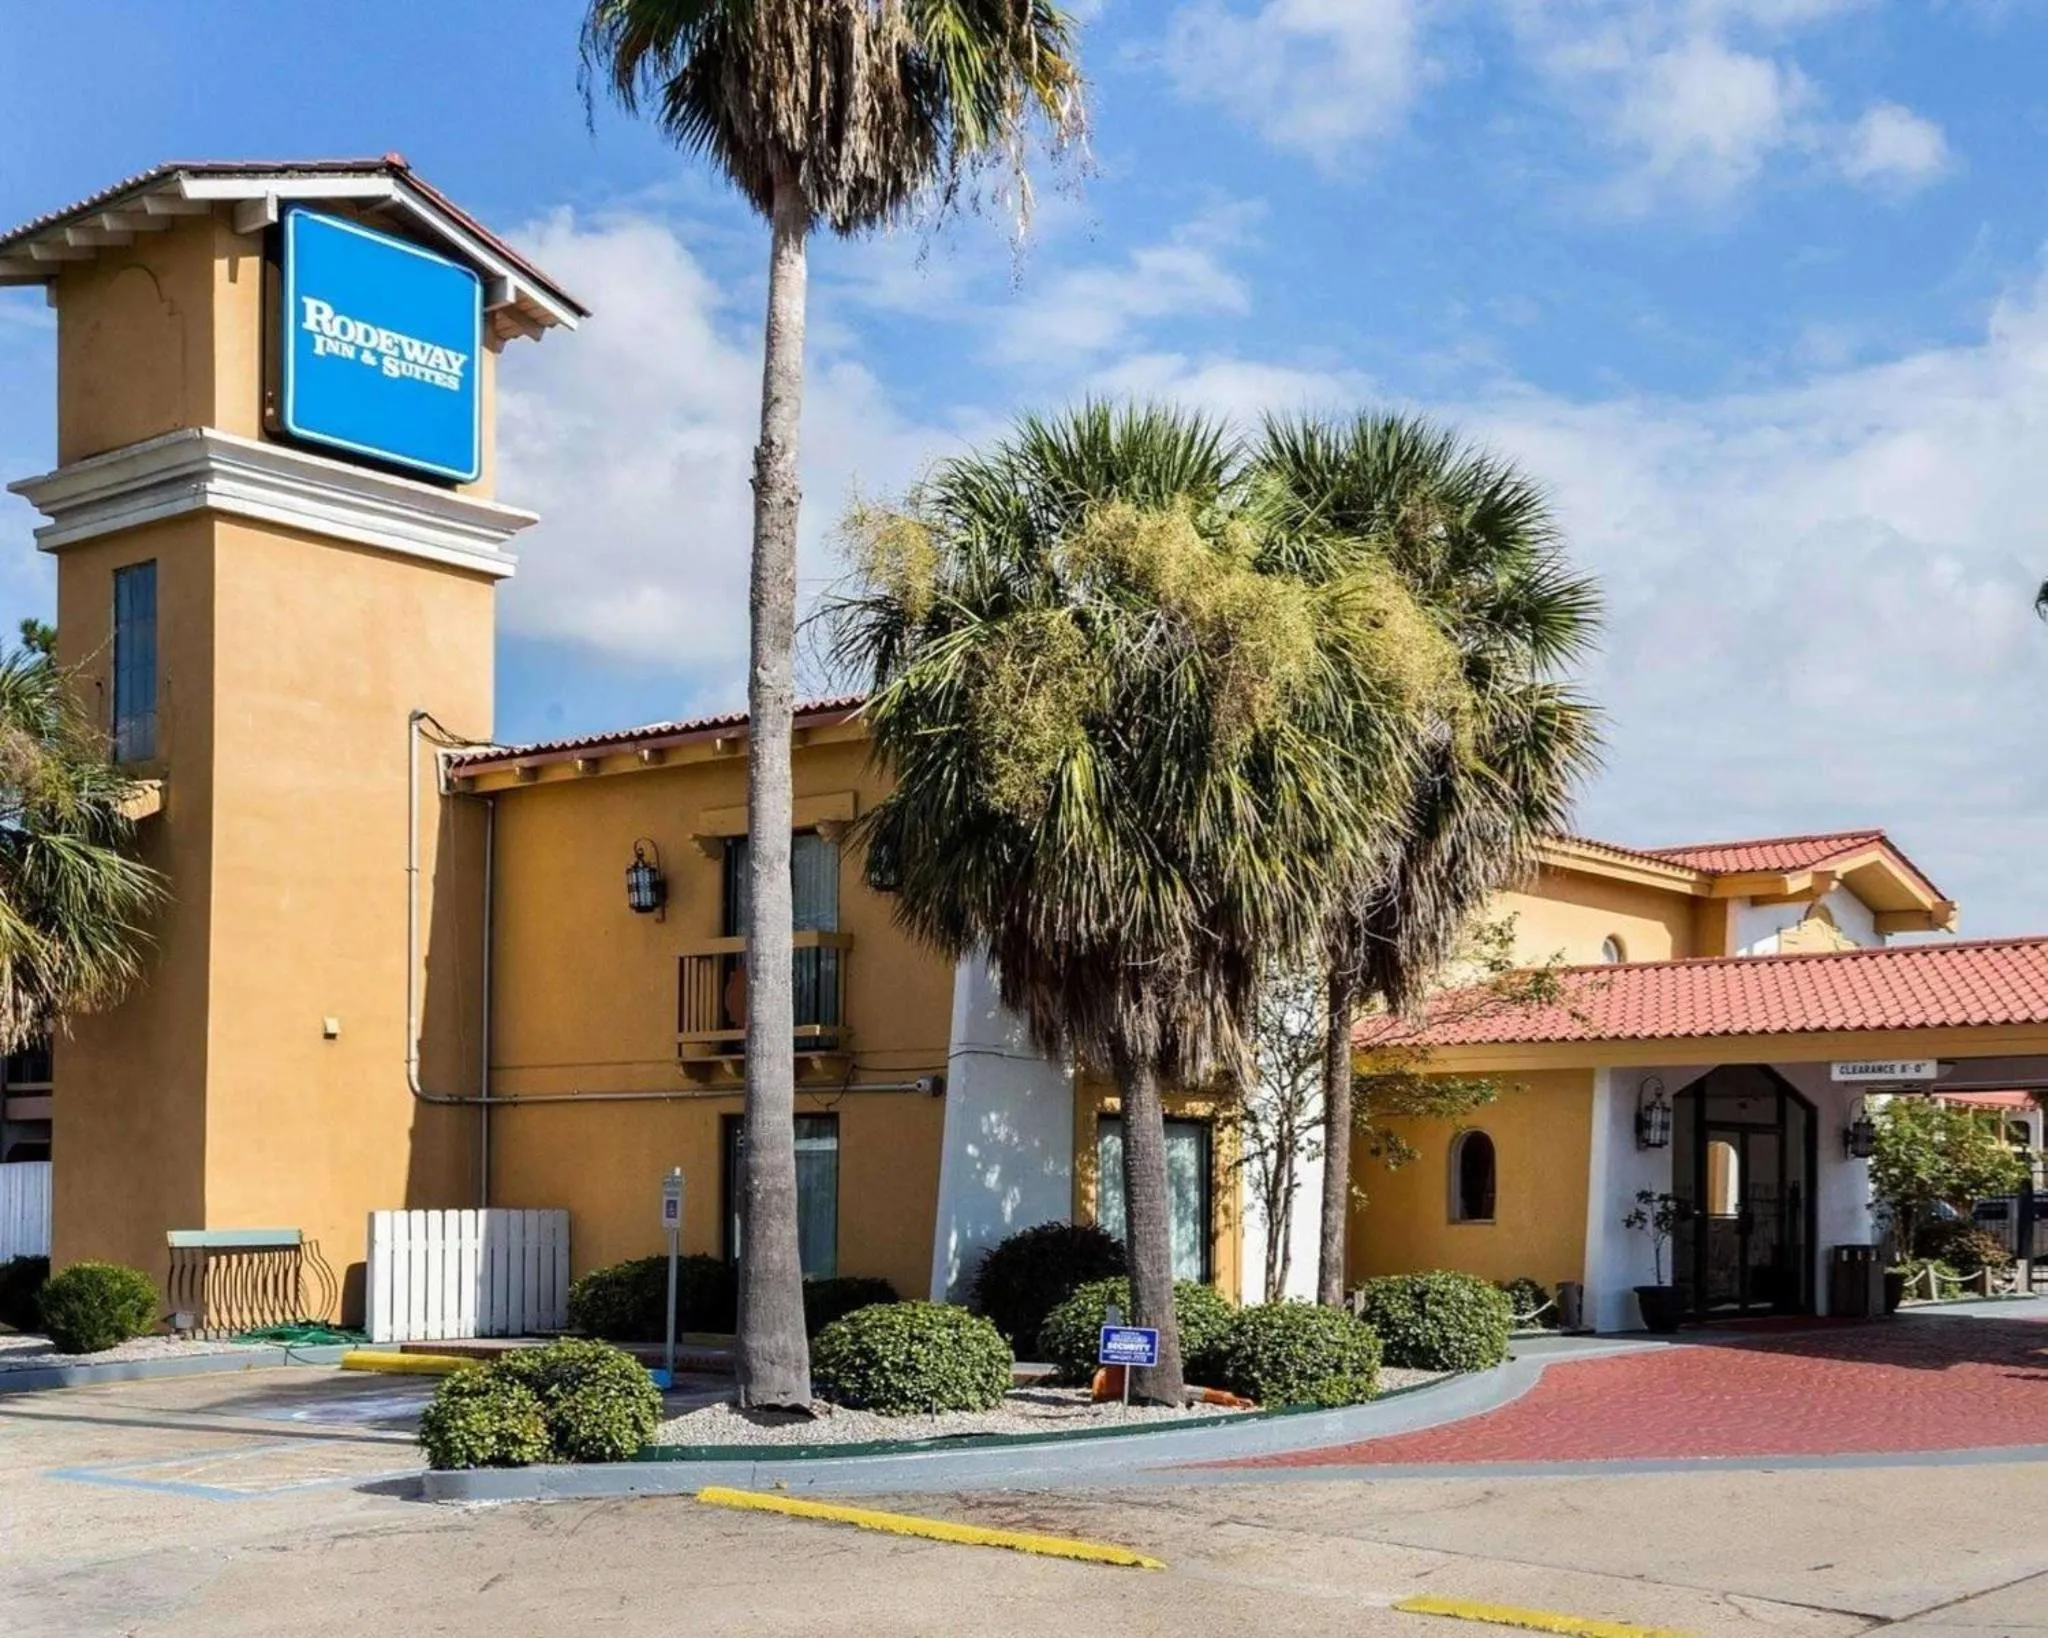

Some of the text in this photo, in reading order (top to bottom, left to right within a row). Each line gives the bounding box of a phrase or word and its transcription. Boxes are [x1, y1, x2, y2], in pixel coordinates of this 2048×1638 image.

[301, 296, 469, 376] RODEWAY
[313, 333, 460, 392] INN & SUITES
[1840, 1063, 1897, 1075] CLEARANCE
[1107, 1341, 1151, 1352] SECURITY
